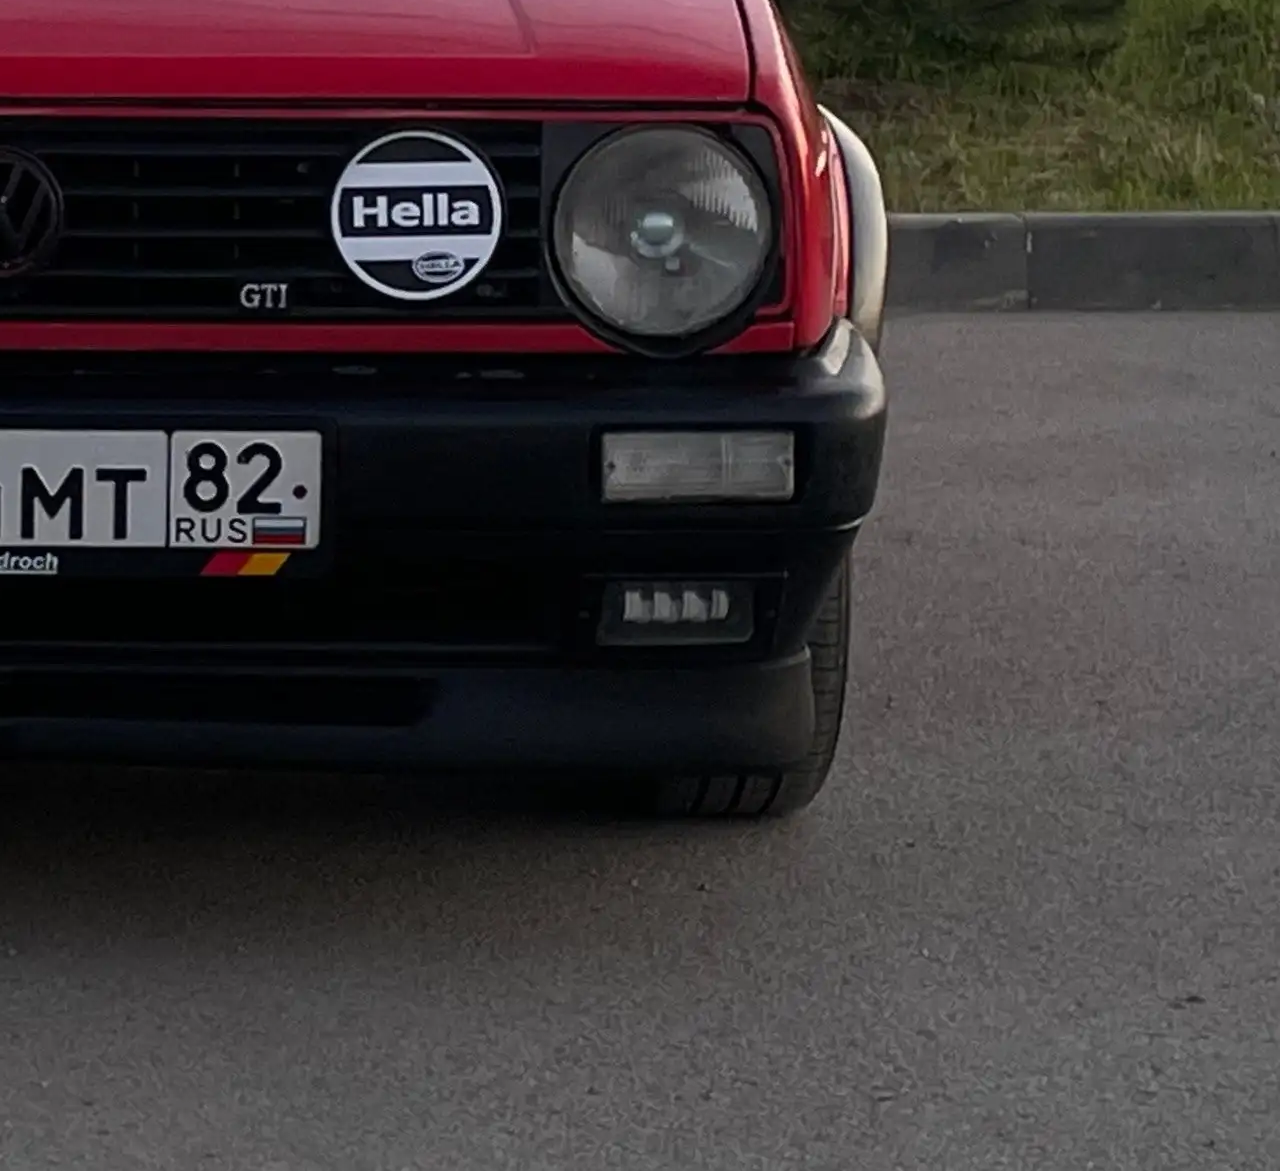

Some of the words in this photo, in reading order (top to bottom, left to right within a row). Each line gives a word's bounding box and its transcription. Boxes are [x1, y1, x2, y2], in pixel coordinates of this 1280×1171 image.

[351, 192, 481, 228] Hella
[239, 282, 289, 309] GTI
[182, 442, 284, 515] 82
[174, 518, 248, 544] RUS
